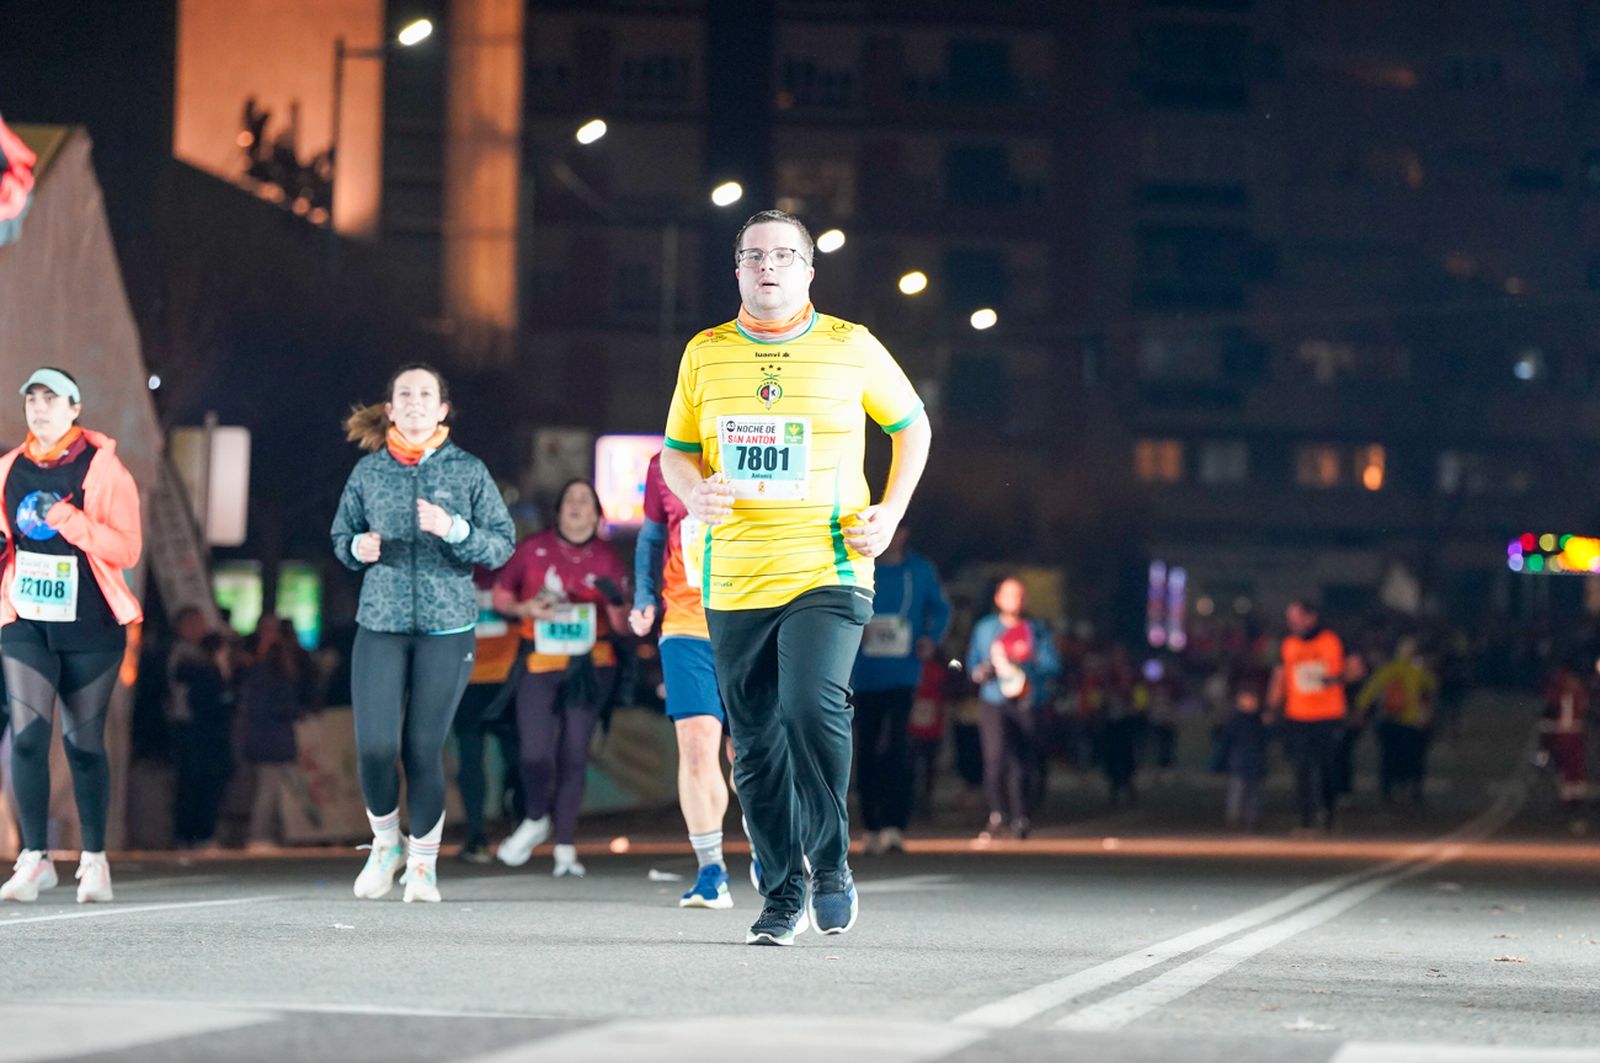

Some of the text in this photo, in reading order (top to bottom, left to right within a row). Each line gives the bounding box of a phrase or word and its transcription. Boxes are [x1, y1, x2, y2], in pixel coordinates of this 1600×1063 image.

[737, 425, 764, 433] NOCHE
[765, 425, 776, 433] DE
[728, 434, 744, 443] SAN
[736, 446, 790, 471] 7801
[20, 577, 65, 598] 12108
